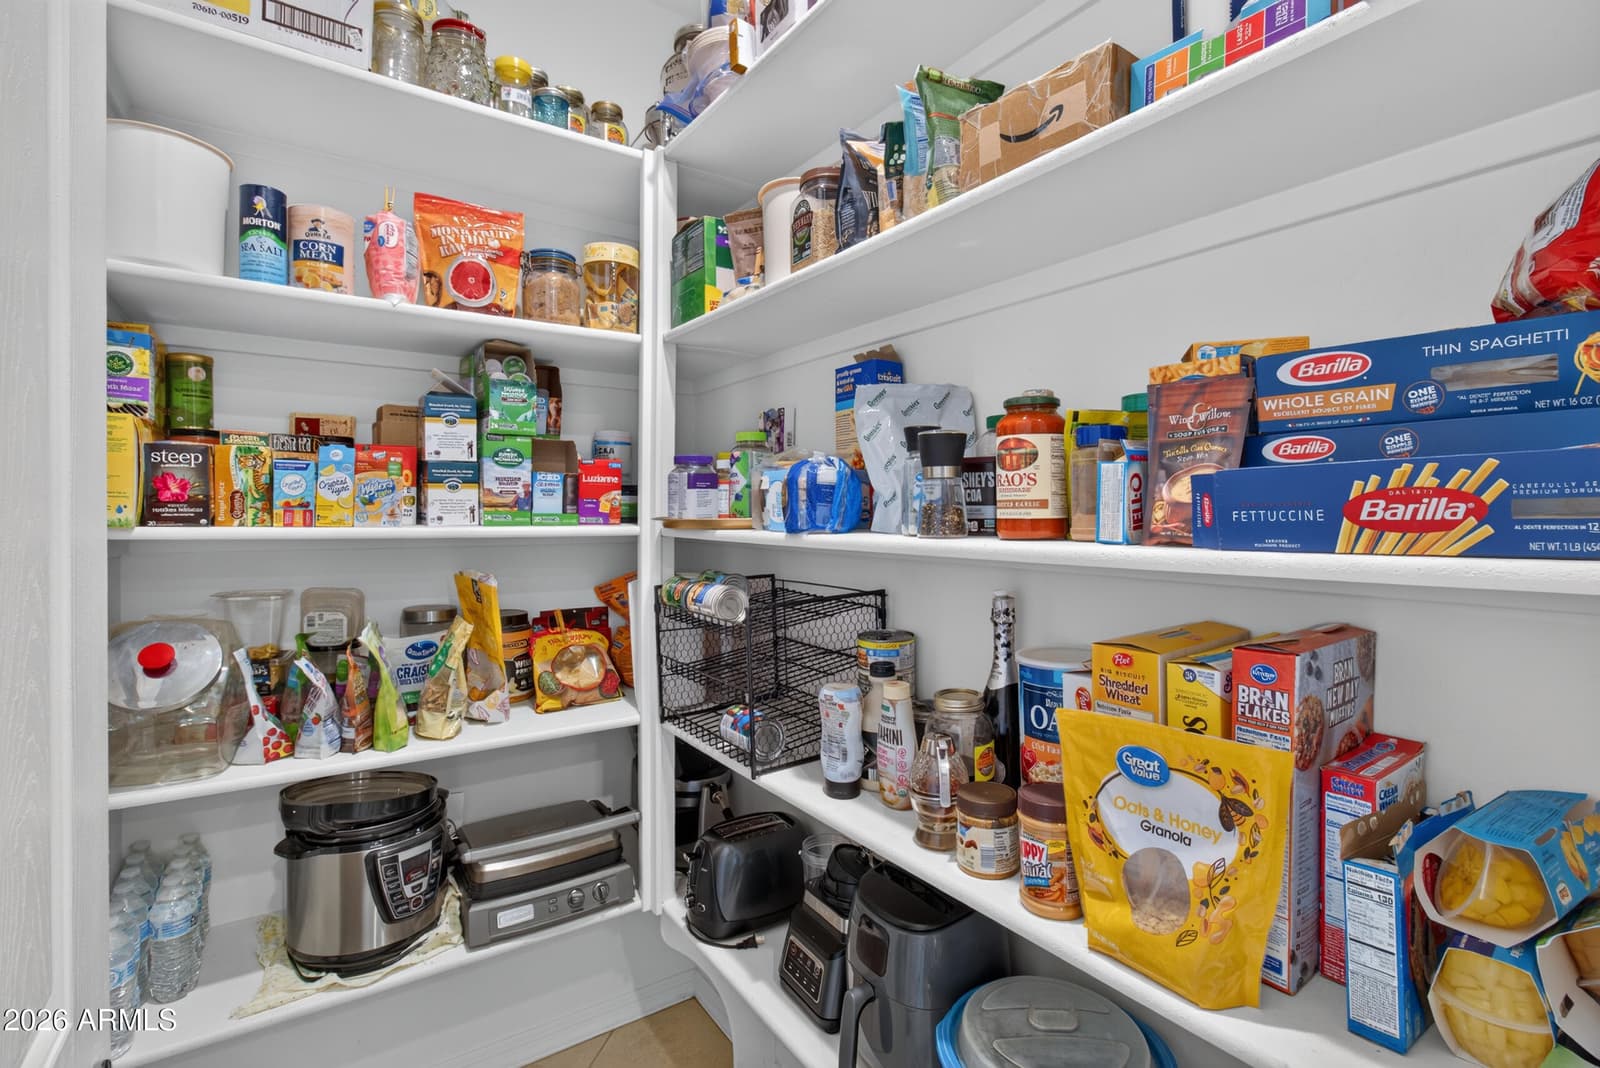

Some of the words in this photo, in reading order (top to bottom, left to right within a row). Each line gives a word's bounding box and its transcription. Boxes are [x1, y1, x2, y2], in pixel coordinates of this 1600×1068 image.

[242, 217, 282, 232] MORTON
[259, 246, 282, 257] SALT
[300, 240, 337, 253] CORN
[300, 251, 337, 263] MEAL
[1422, 342, 1461, 357] THIN
[1470, 328, 1569, 351] SPAGHETTI
[1297, 357, 1363, 378] Barilla
[1263, 395, 1324, 412] WHOLE
[1330, 387, 1390, 404] GRAIN
[1407, 385, 1437, 399] ONE
[1535, 400, 1550, 409] NET
[1569, 398, 1577, 406] 16
[1580, 396, 1593, 405] OZ
[1273, 409, 1310, 417] EXCELLENT
[1384, 432, 1412, 445] ONE
[1278, 440, 1330, 456] Barilla
[151, 450, 203, 468] steep
[582, 474, 619, 484] Luzianne
[963, 471, 995, 488] SHEY'S
[997, 473, 1037, 487] RAO'S
[1512, 481, 1577, 489] CAREFULLY
[965, 489, 982, 502] COA
[1232, 508, 1325, 522] FETTUCCINE
[1360, 497, 1467, 520] Barilla
[1529, 542, 1546, 551] NET
[1569, 542, 1581, 551] LB
[396, 665, 430, 680] CRAIS
[1098, 674, 1149, 696] Shredded
[1105, 687, 1142, 706] Wheat
[1237, 685, 1290, 712] BRAN
[1030, 704, 1059, 730] OA
[1237, 702, 1291, 726] FLAKES
[1121, 752, 1161, 772] Great
[1130, 765, 1161, 781] Value
[1113, 796, 1150, 818] Oats
[1153, 807, 1165, 823] &
[1169, 812, 1224, 844] Honey
[1140, 819, 1192, 847] Granola
[1021, 840, 1045, 862] PPY
